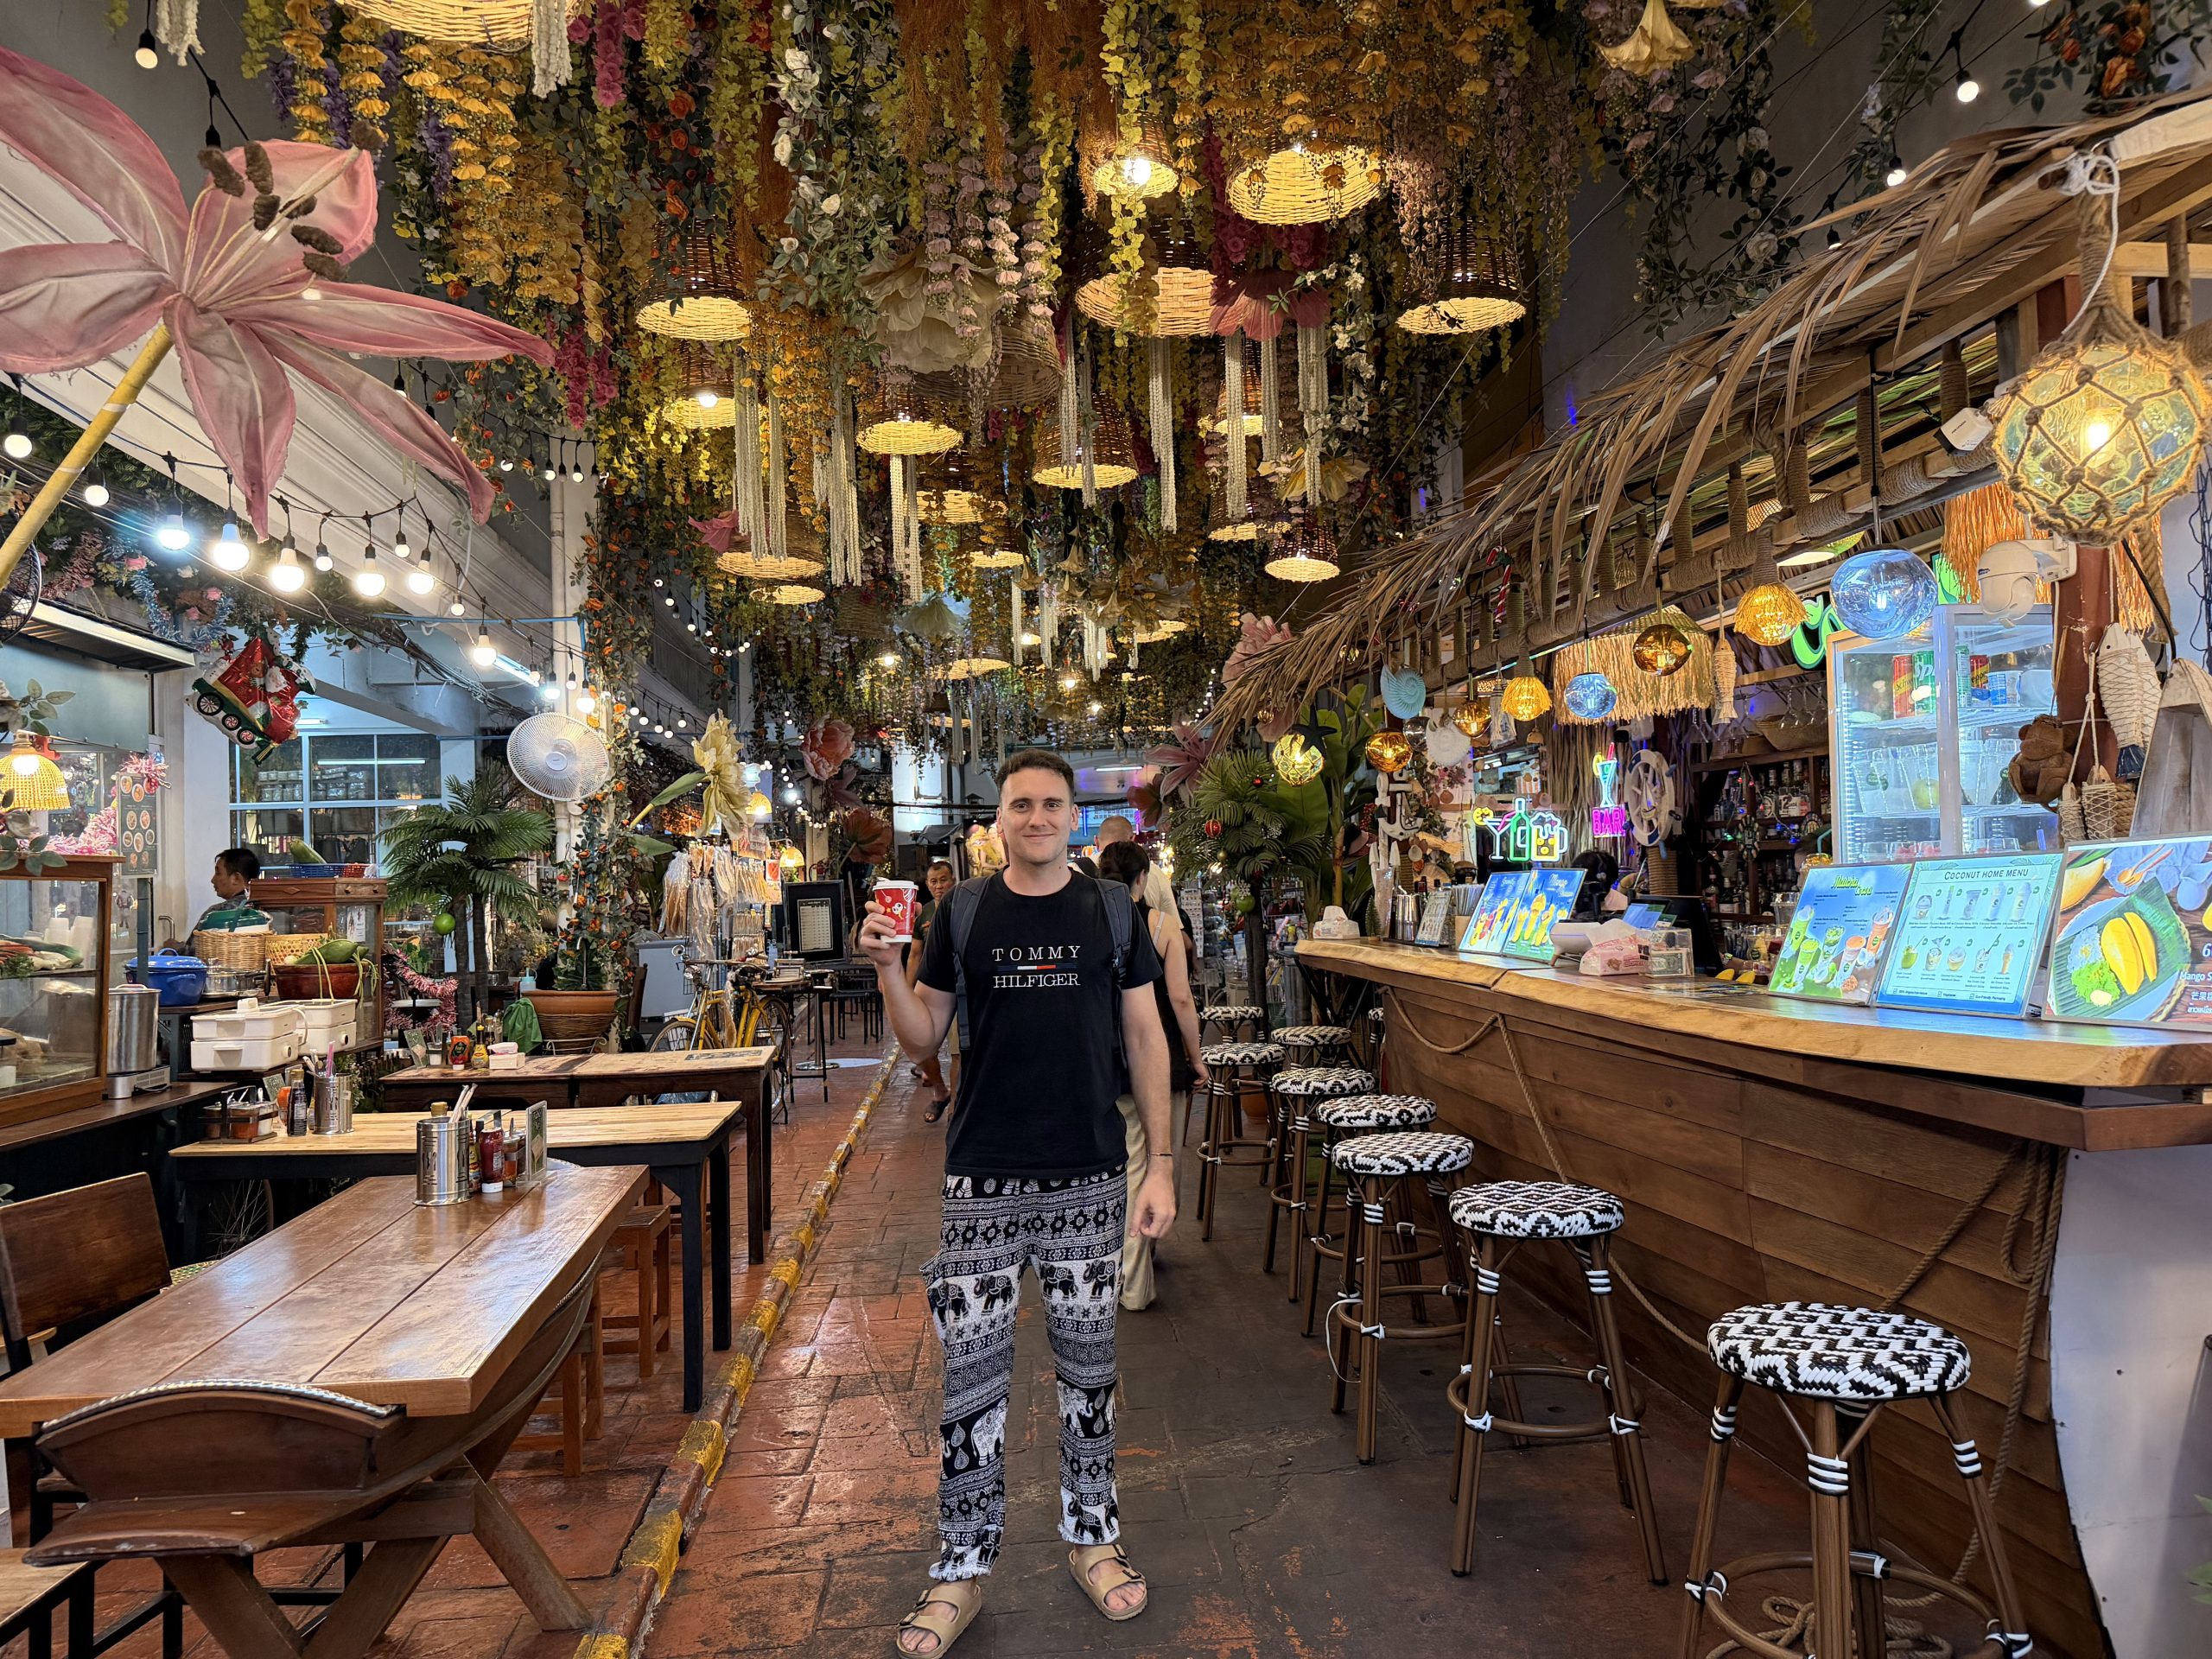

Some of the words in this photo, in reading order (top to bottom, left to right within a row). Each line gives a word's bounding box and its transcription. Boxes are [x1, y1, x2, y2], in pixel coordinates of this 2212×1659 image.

[1944, 871, 1980, 880] COCONUT
[2005, 868, 2029, 877] MENU
[992, 946, 1081, 962] TOMMY
[993, 974, 1081, 988] HILFIGER
[2180, 971, 2205, 982] Mango
